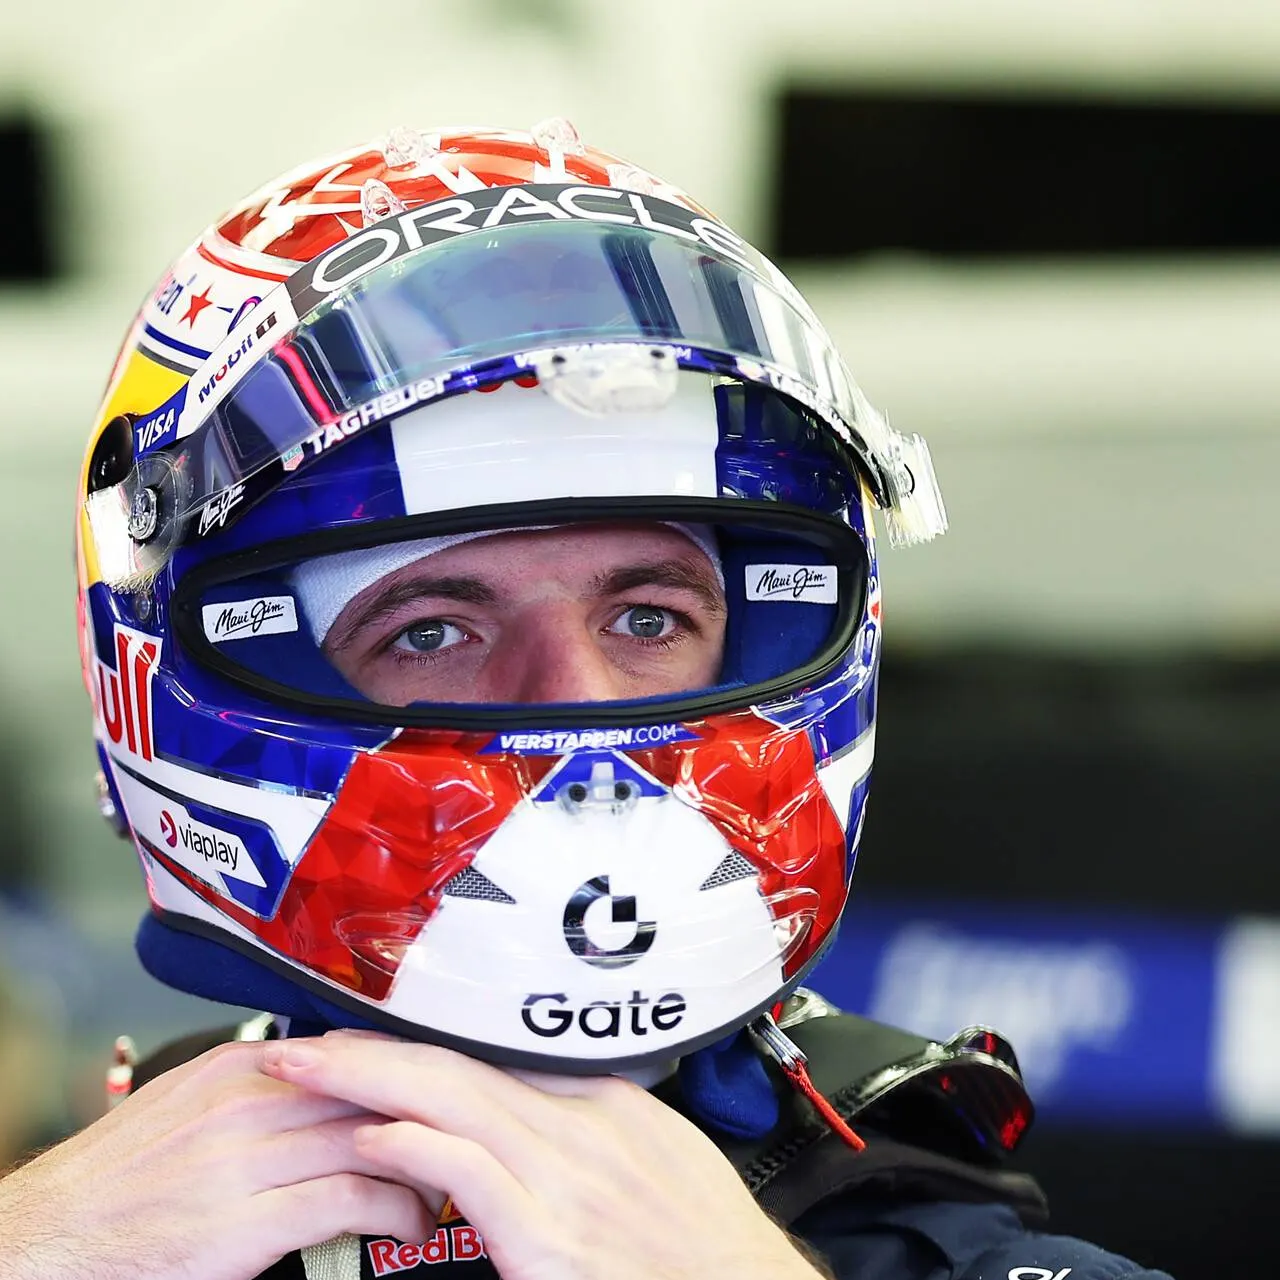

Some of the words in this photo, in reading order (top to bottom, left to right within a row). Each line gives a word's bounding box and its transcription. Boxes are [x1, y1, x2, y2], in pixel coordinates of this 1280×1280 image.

[310, 186, 758, 294] ORACLE
[198, 334, 254, 403] Mobil
[136, 408, 176, 452] VISA
[755, 569, 791, 594] Maui
[792, 568, 827, 598] Jim
[214, 607, 250, 634] Maui
[250, 600, 285, 633] Jim
[98, 631, 157, 763] ull
[500, 724, 677, 750] VERSTAPPEN.COM
[180, 822, 239, 870] viaplay
[521, 989, 687, 1039] Gate
[369, 1230, 448, 1275] Red
